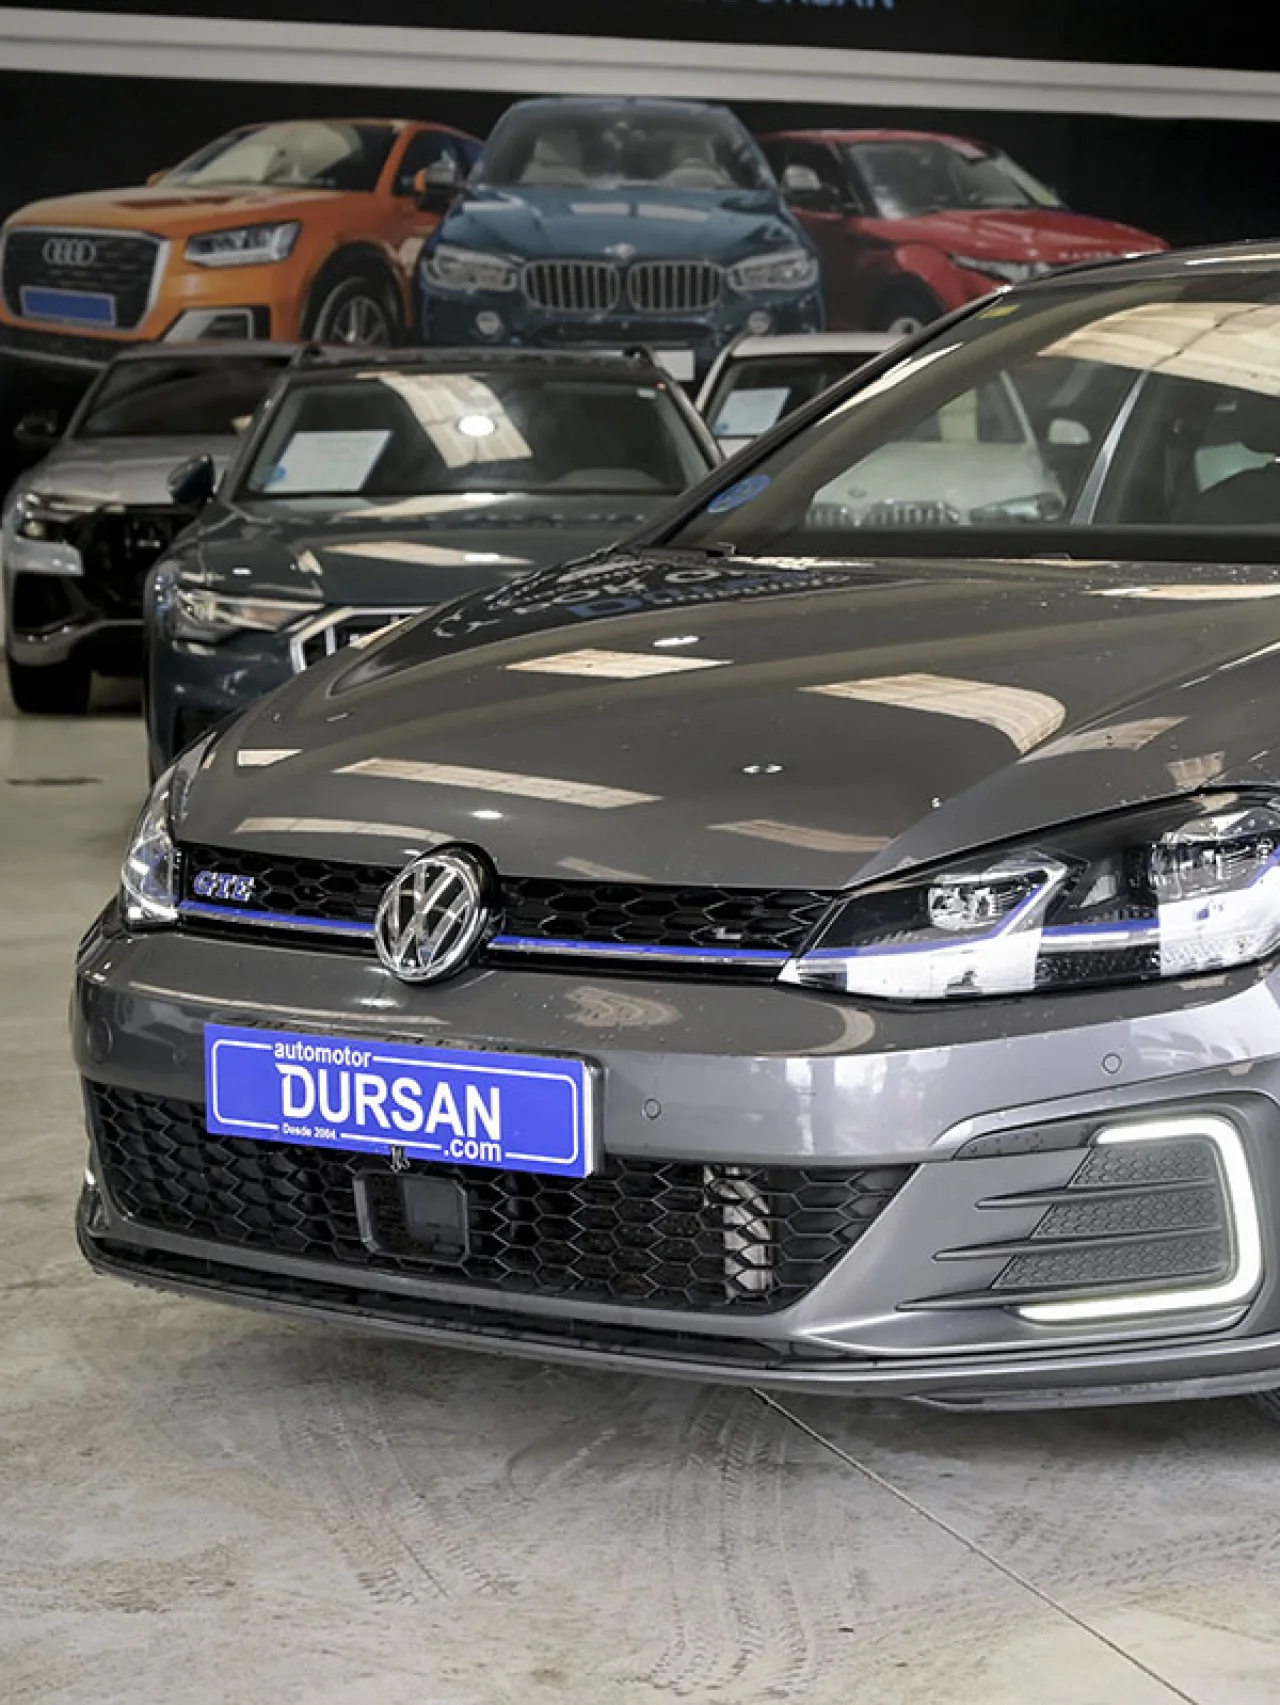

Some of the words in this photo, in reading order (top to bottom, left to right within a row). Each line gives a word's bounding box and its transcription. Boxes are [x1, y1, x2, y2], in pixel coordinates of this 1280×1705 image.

[194, 870, 255, 902] GTE
[273, 1040, 371, 1068] automotor
[275, 1062, 501, 1140] DURSAN
[443, 1137, 501, 1163] .com
